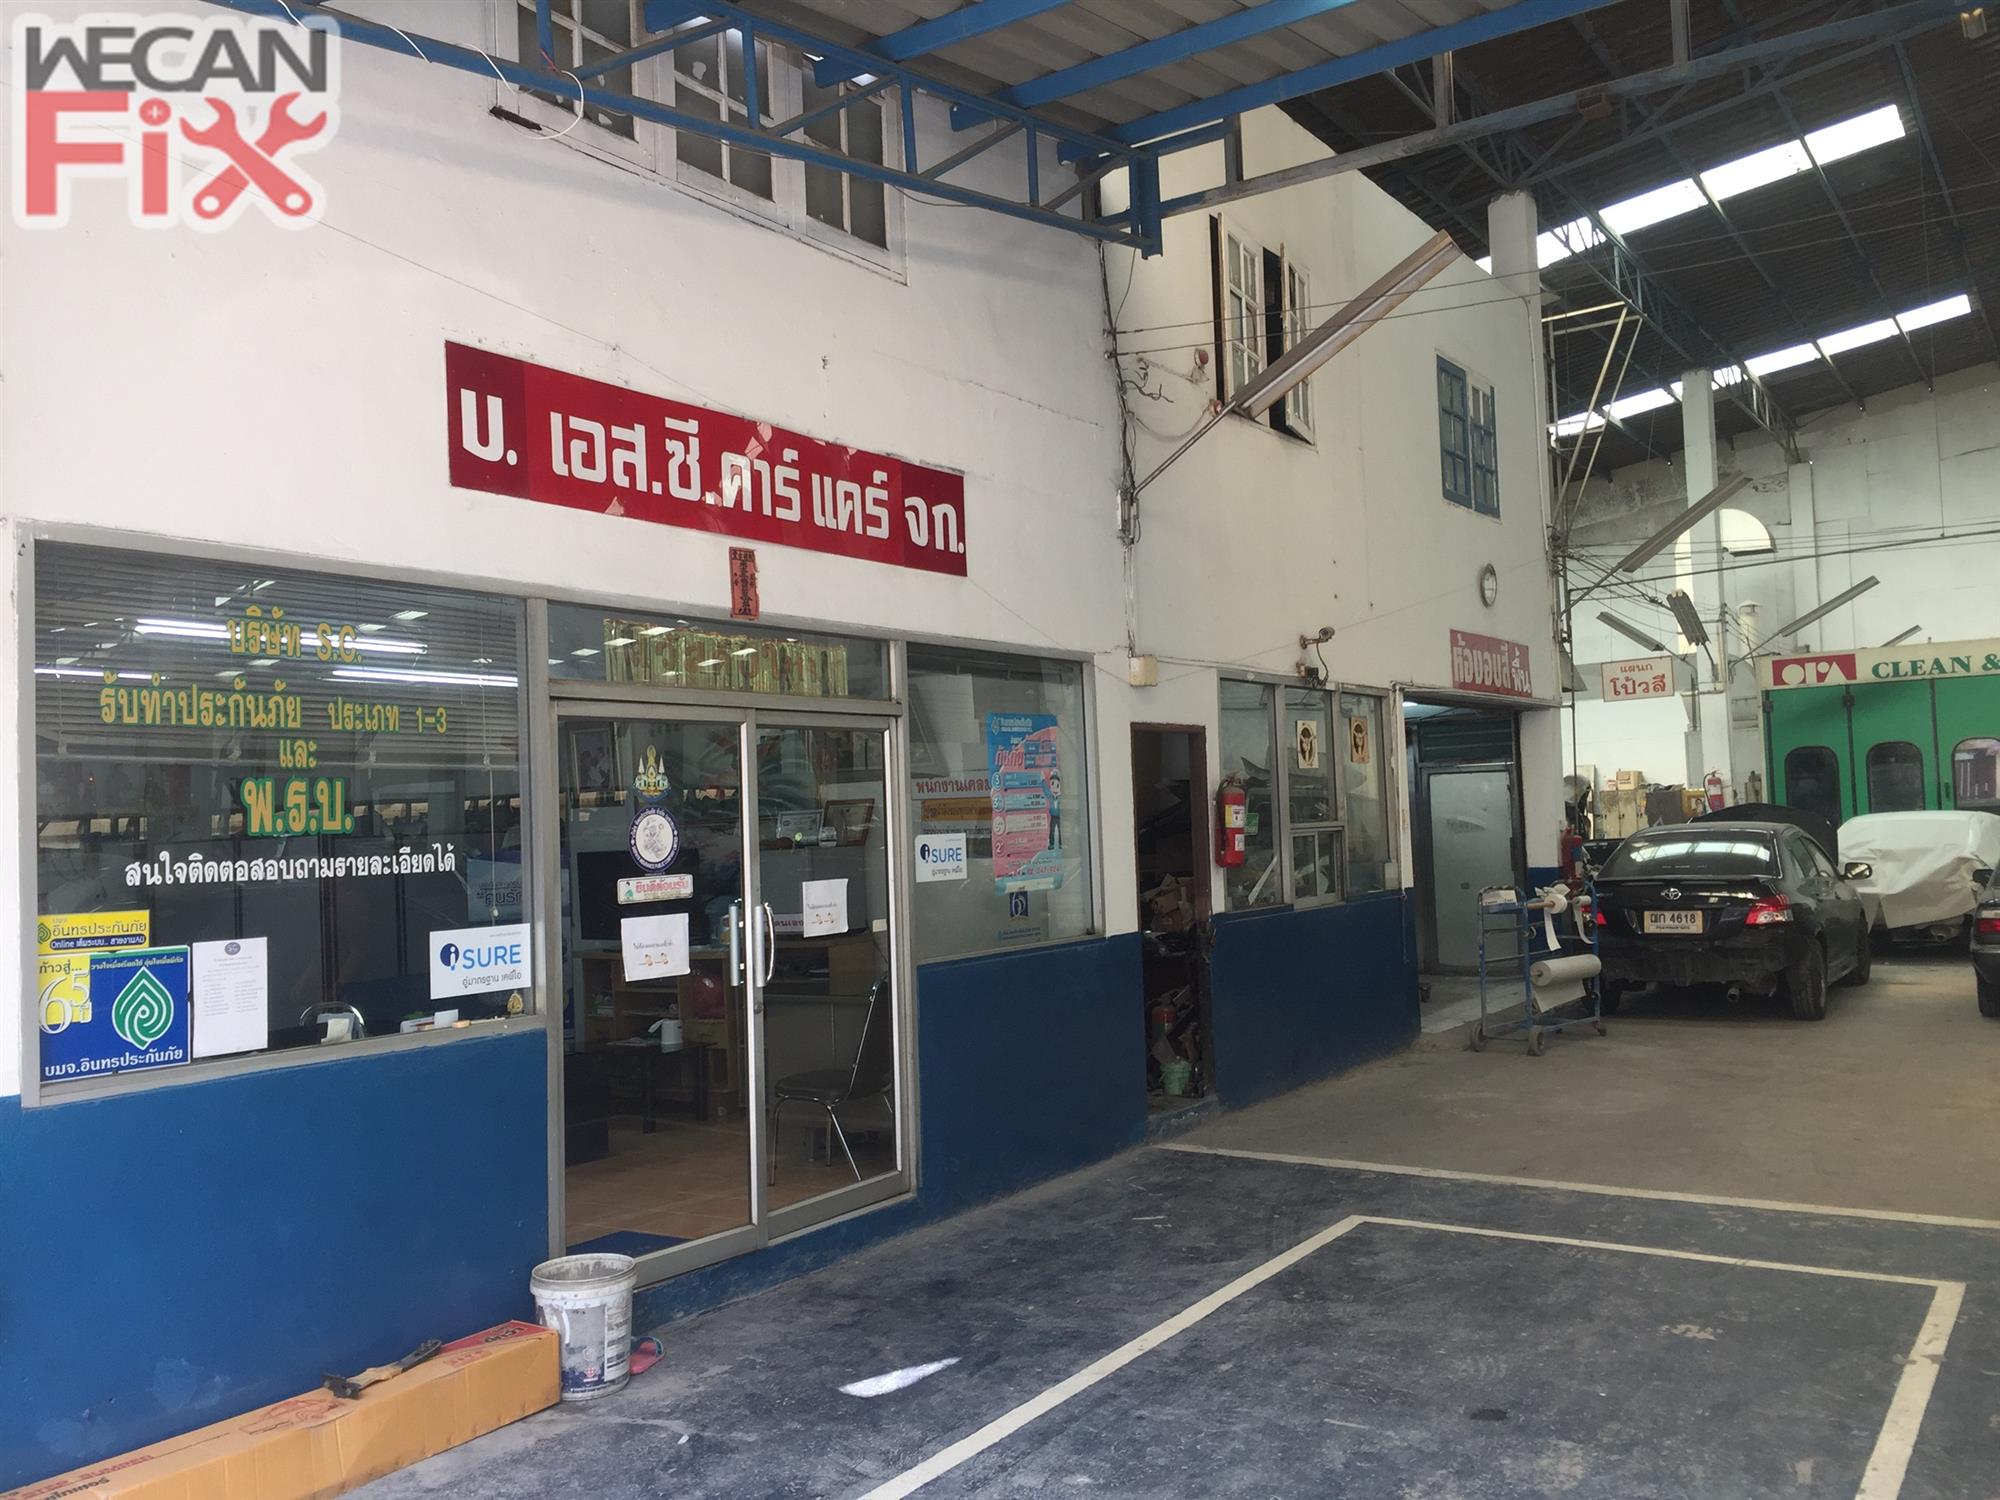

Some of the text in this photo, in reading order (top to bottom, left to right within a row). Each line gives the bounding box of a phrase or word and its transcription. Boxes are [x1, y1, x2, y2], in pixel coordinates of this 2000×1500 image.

[459, 387, 519, 467] บ.
[811, 469, 890, 540] แคร์
[904, 496, 965, 554] จก.
[226, 604, 364, 663] บริษัท S.C.
[1619, 662, 1654, 673] แผนก
[1871, 655, 1972, 679] CLEAN
[1609, 673, 1667, 697] โป้วสี
[100, 670, 448, 734] รับทำประกันภัย ประเภท 1-3
[278, 738, 318, 769] และ
[240, 775, 355, 837] พ.ร.บ.
[51, 920, 147, 938] อินทรประกันภัย
[1670, 912, 1696, 924] 4618
[51, 938, 75, 949] Online
[44, 1045, 184, 1077] บมจ.อินทรประกันภัย
